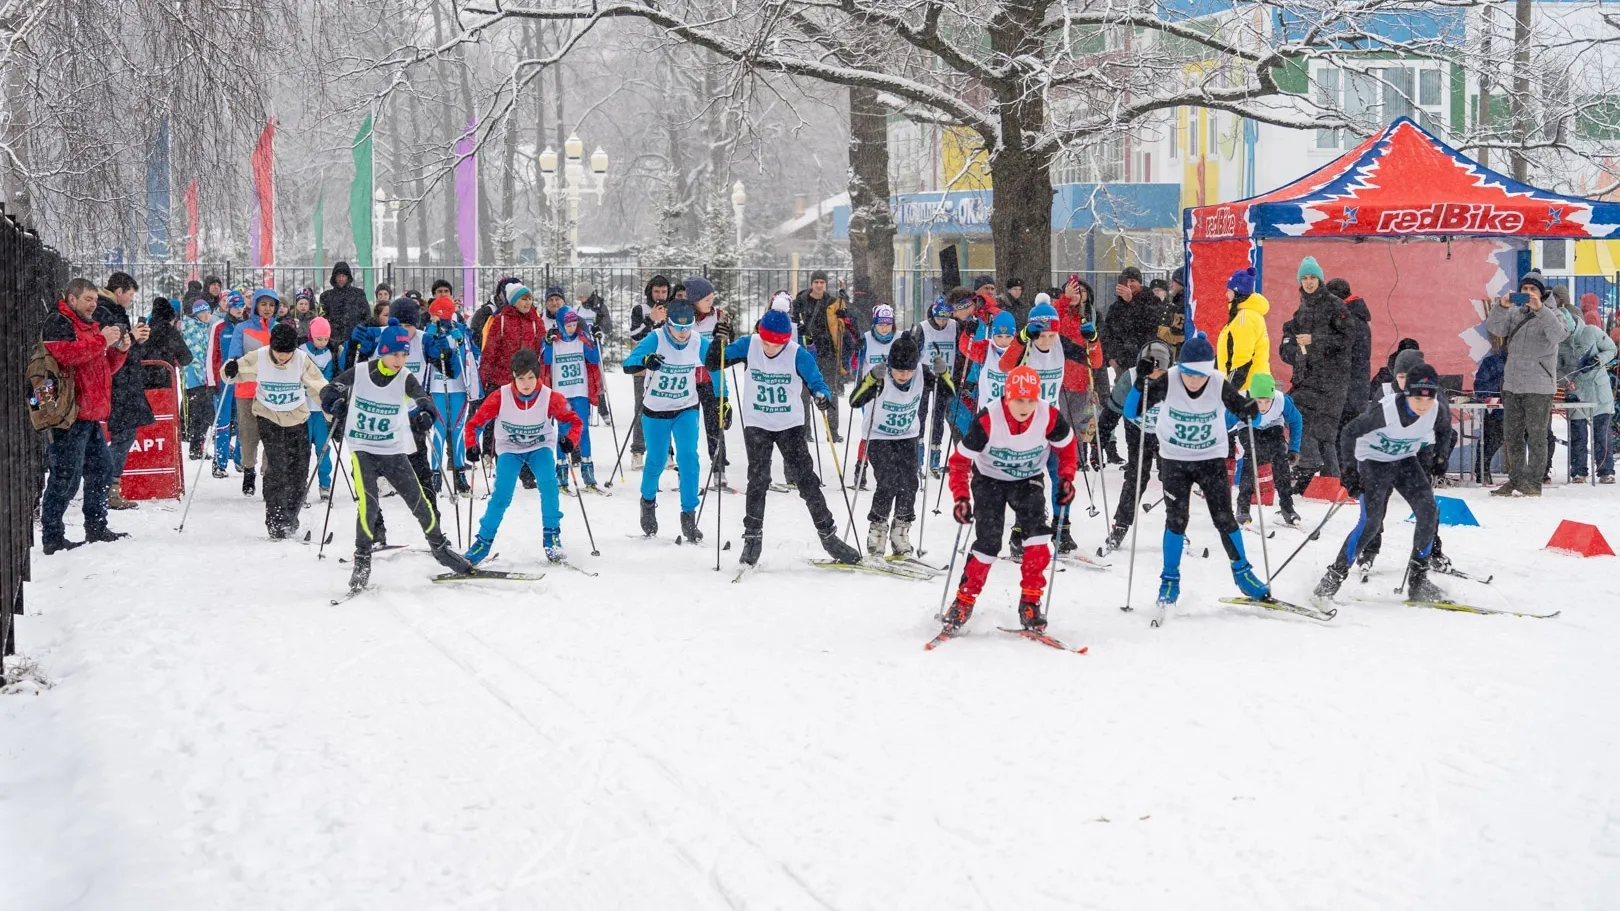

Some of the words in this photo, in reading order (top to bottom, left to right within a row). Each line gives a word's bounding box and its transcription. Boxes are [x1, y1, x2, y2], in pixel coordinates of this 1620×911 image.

[1206, 206, 1235, 238] redBike
[1377, 203, 1525, 234] redBike
[658, 375, 688, 390] 319
[1011, 372, 1038, 389] DNB
[756, 384, 788, 404] 318
[1041, 382, 1057, 400] 14
[1174, 423, 1213, 442] 323
[128, 437, 166, 453] АРТ
